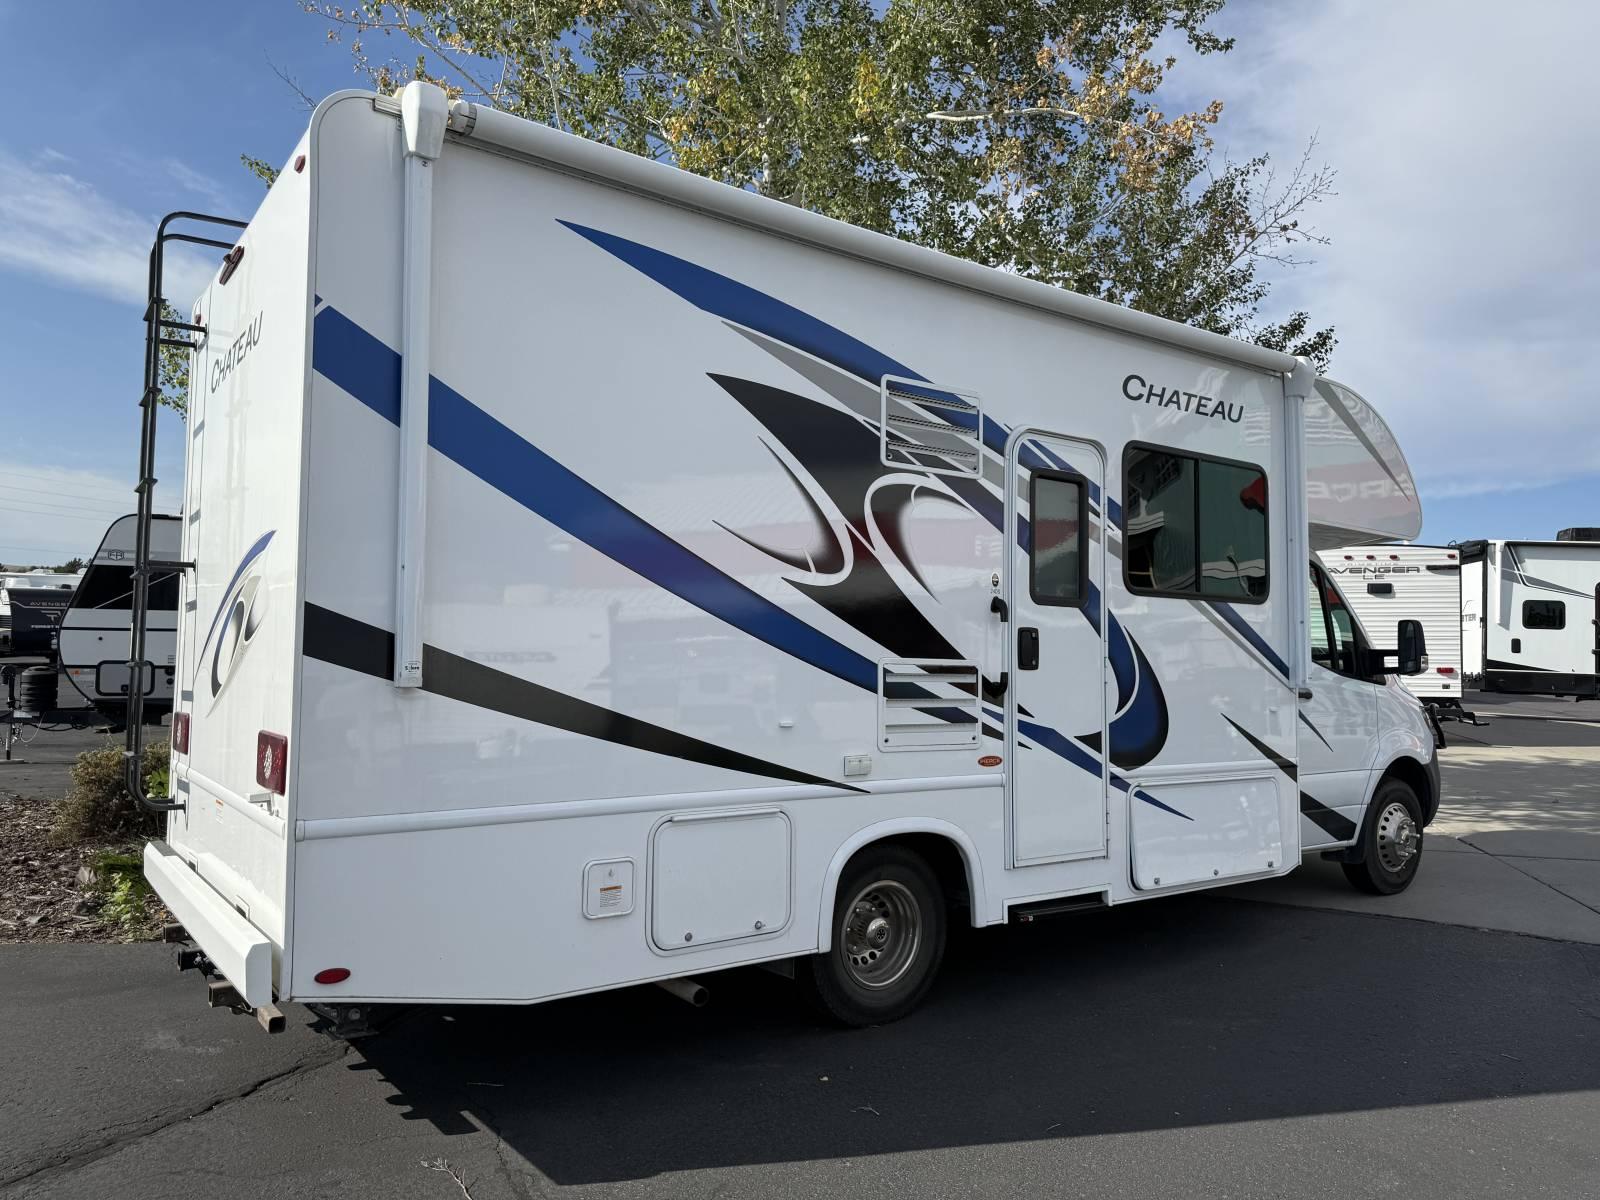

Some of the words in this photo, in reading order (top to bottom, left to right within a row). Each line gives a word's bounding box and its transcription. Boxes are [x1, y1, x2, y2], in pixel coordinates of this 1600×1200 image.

[211, 310, 263, 394] CHATEAU
[1122, 374, 1244, 423] CHATEAU
[1328, 566, 1421, 574] AVENGER
